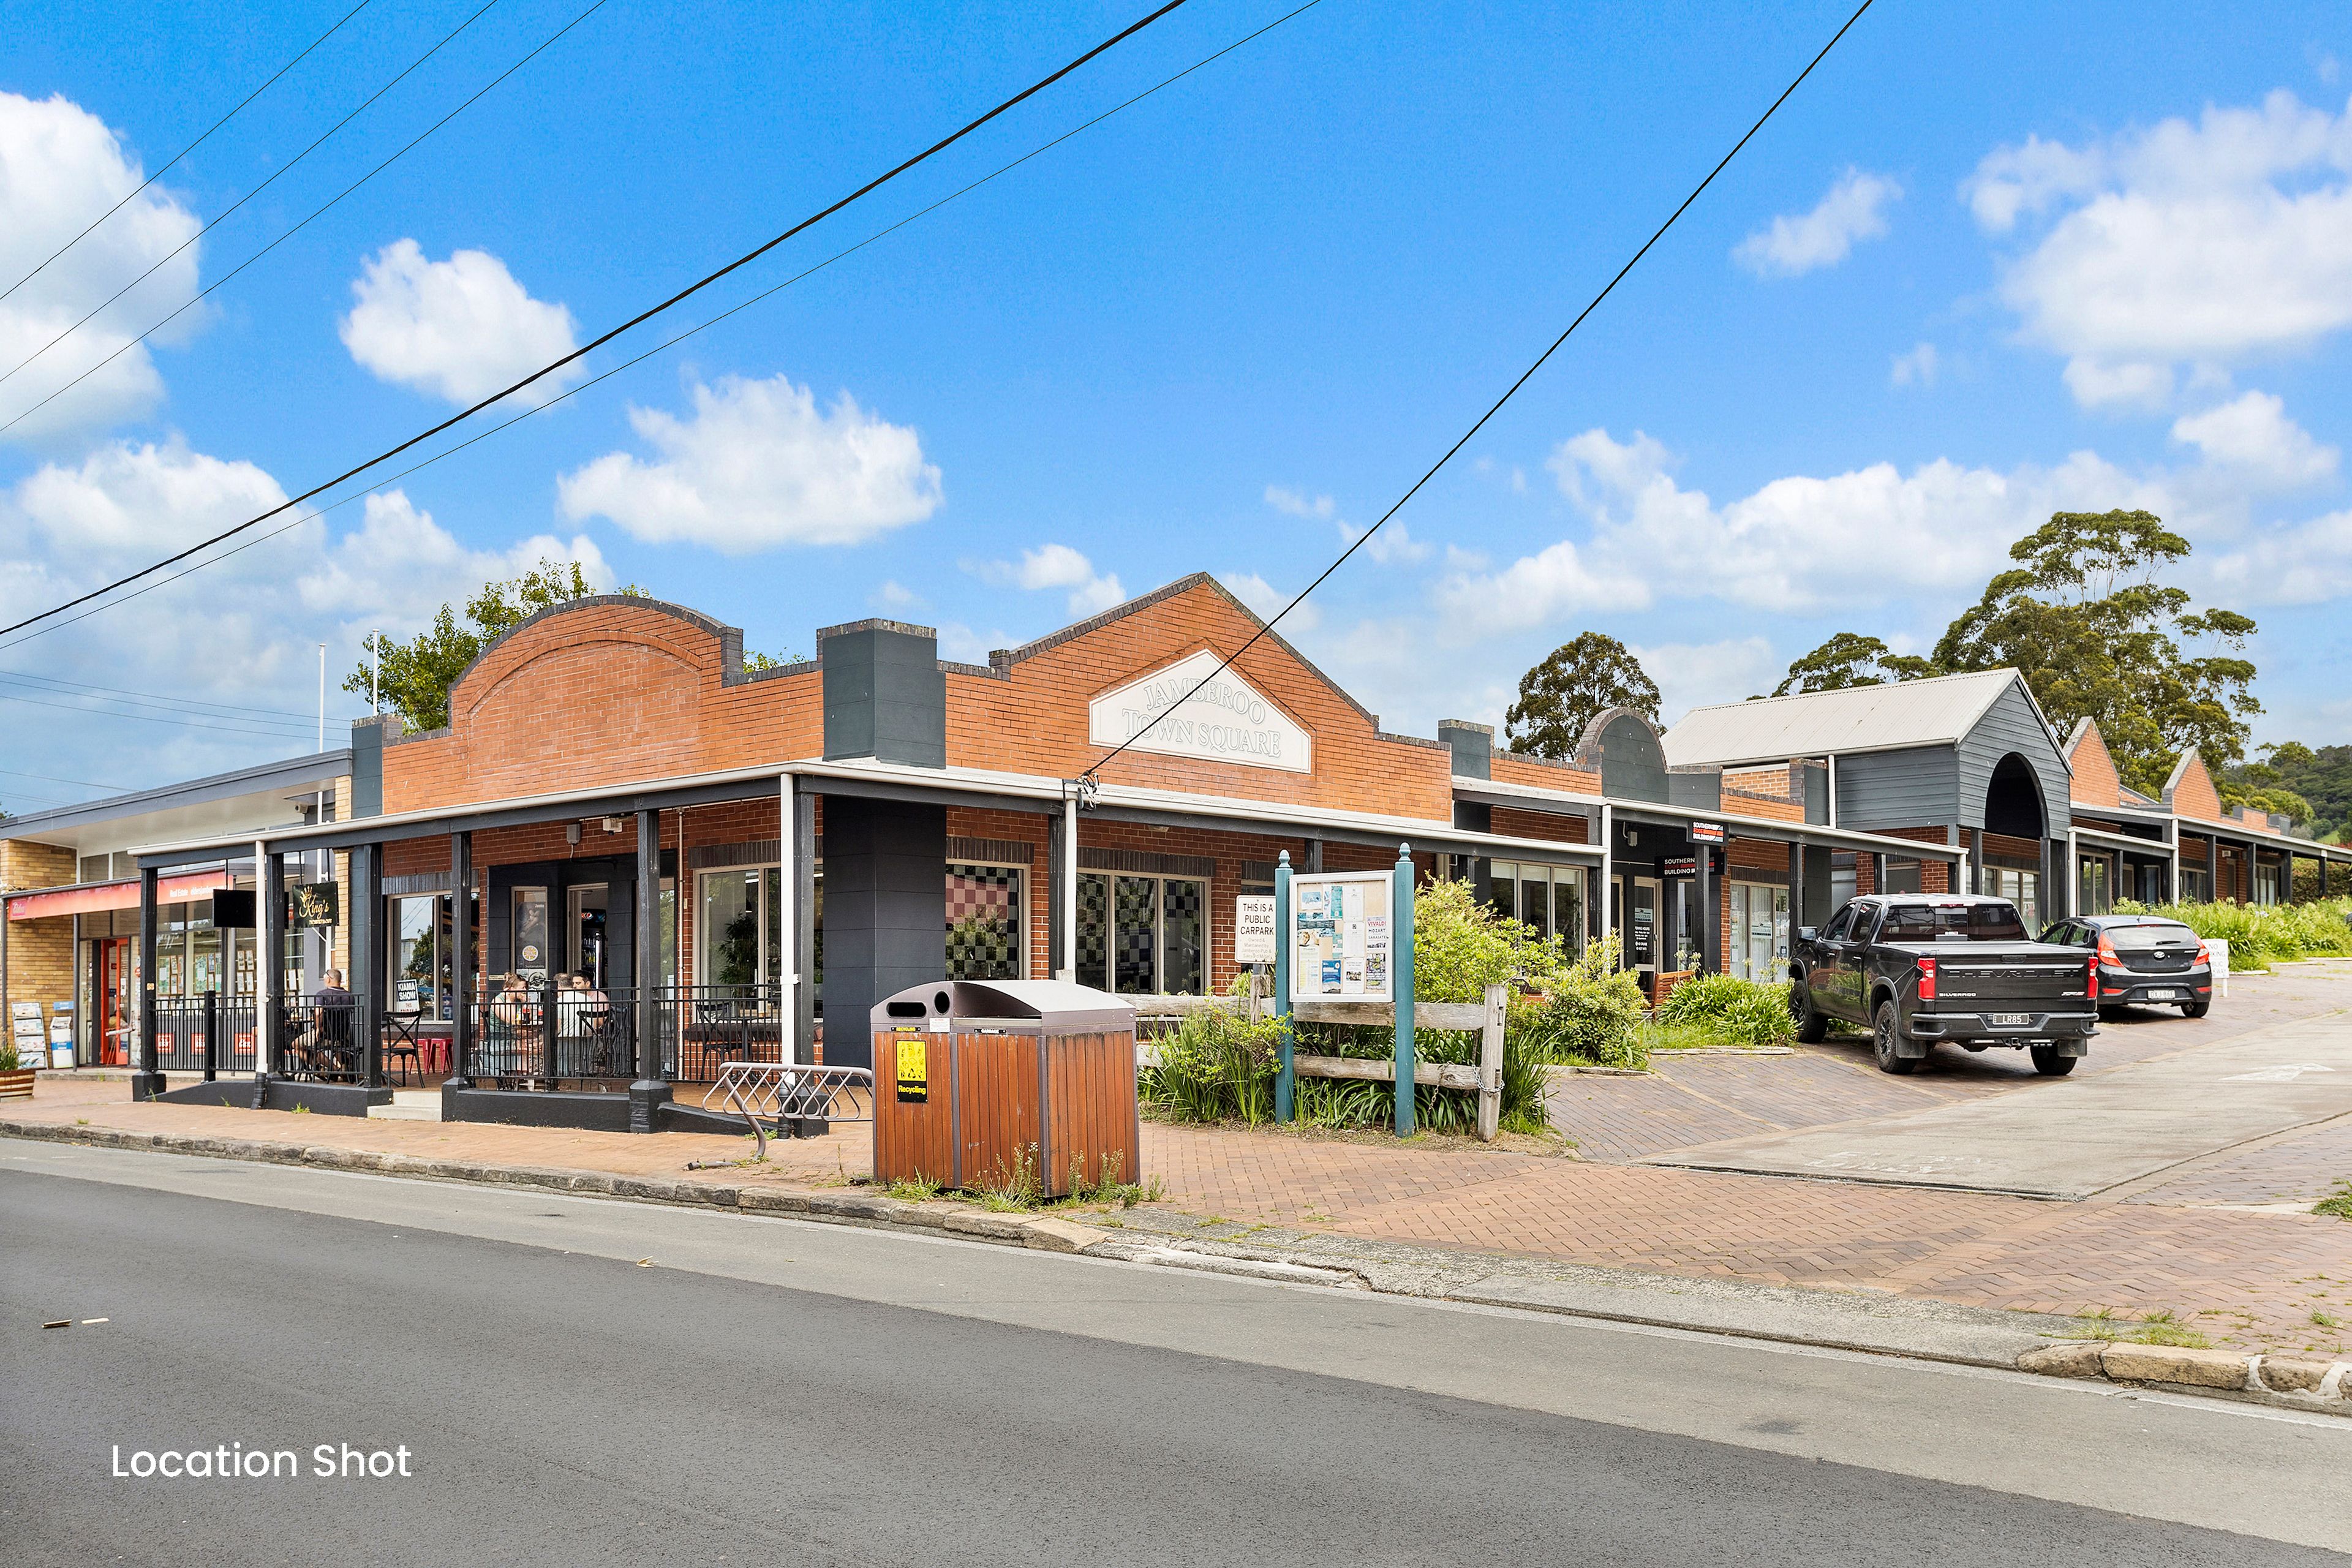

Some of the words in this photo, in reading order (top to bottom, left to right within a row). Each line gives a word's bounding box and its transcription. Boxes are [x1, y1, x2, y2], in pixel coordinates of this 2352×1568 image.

[1143, 677, 1266, 725] JAMBEROO
[1121, 707, 1194, 745] TOWN
[1198, 722, 1281, 758] SQUARE
[299, 894, 330, 919] King's
[1260, 903, 1267, 912] IS
[1268, 903, 1273, 912] A
[1245, 914, 1270, 924] PUBLIC
[1240, 926, 1274, 935] CARPARK
[398, 982, 415, 991] KIAMA
[399, 991, 416, 1000] SHOW
[2002, 1015, 2022, 1023] LR85
[898, 1085, 926, 1095] Recycling
